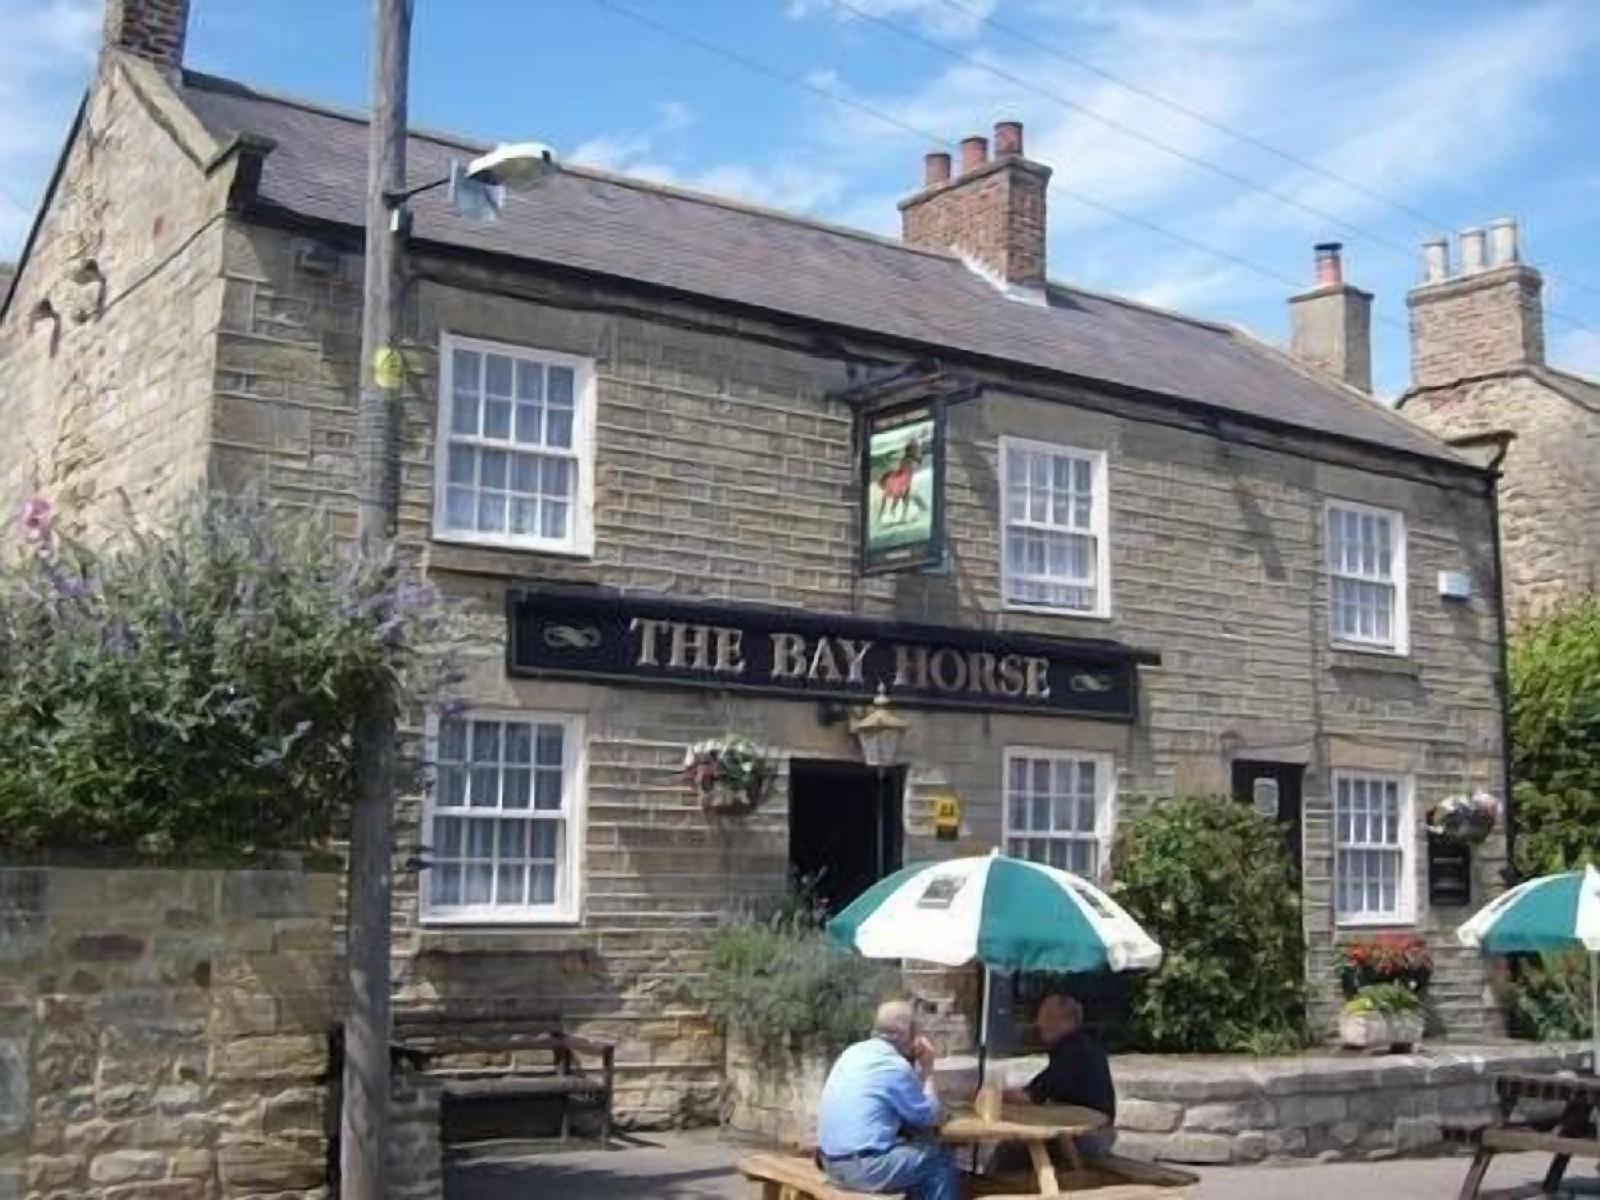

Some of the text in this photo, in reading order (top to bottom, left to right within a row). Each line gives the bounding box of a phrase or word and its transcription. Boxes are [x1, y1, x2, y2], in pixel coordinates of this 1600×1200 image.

[629, 617, 1051, 698] THE BAY HORSE
